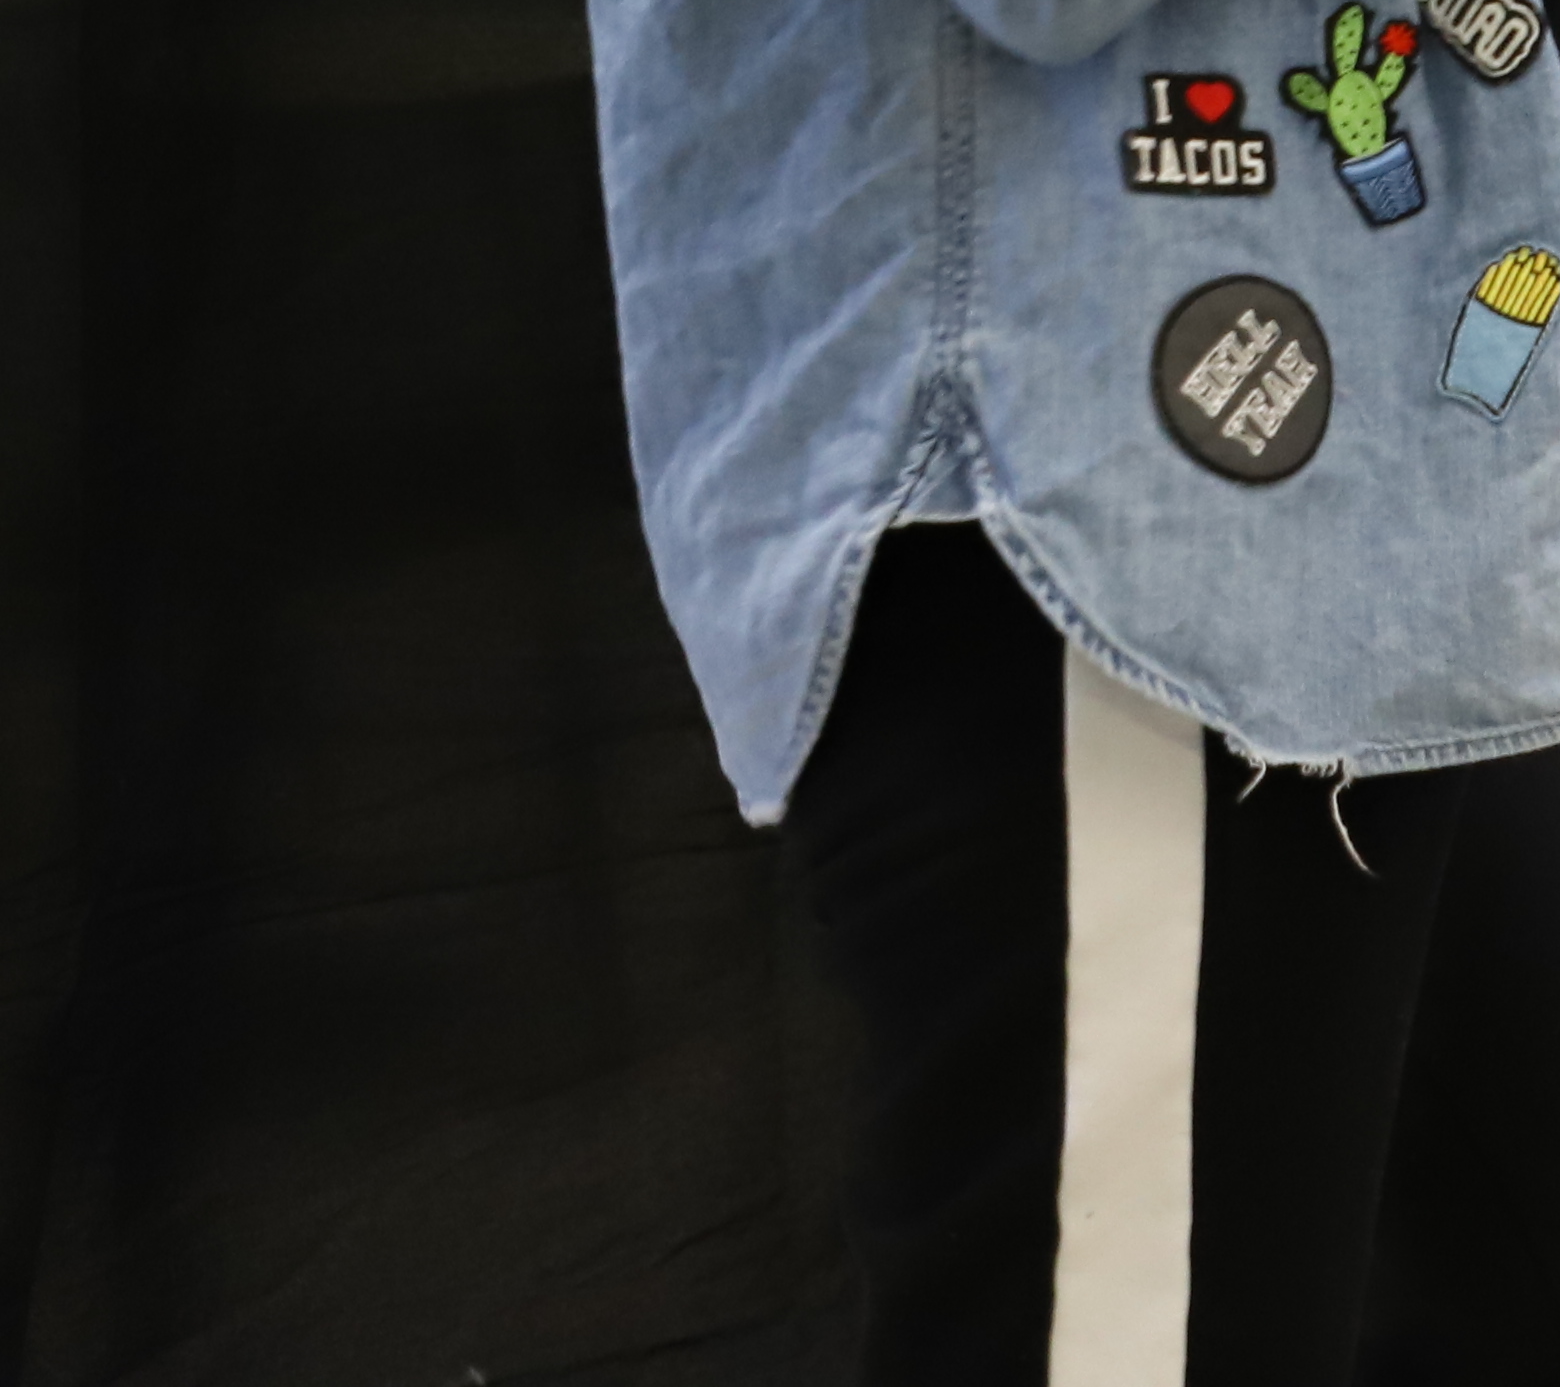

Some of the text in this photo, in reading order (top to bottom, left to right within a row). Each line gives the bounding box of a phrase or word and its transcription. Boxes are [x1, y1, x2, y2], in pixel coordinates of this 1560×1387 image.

[1152, 79, 1173, 124] I
[1130, 136, 1267, 185] TACOS
[1180, 308, 1283, 419] HELL
[1221, 339, 1319, 457] YEAH
